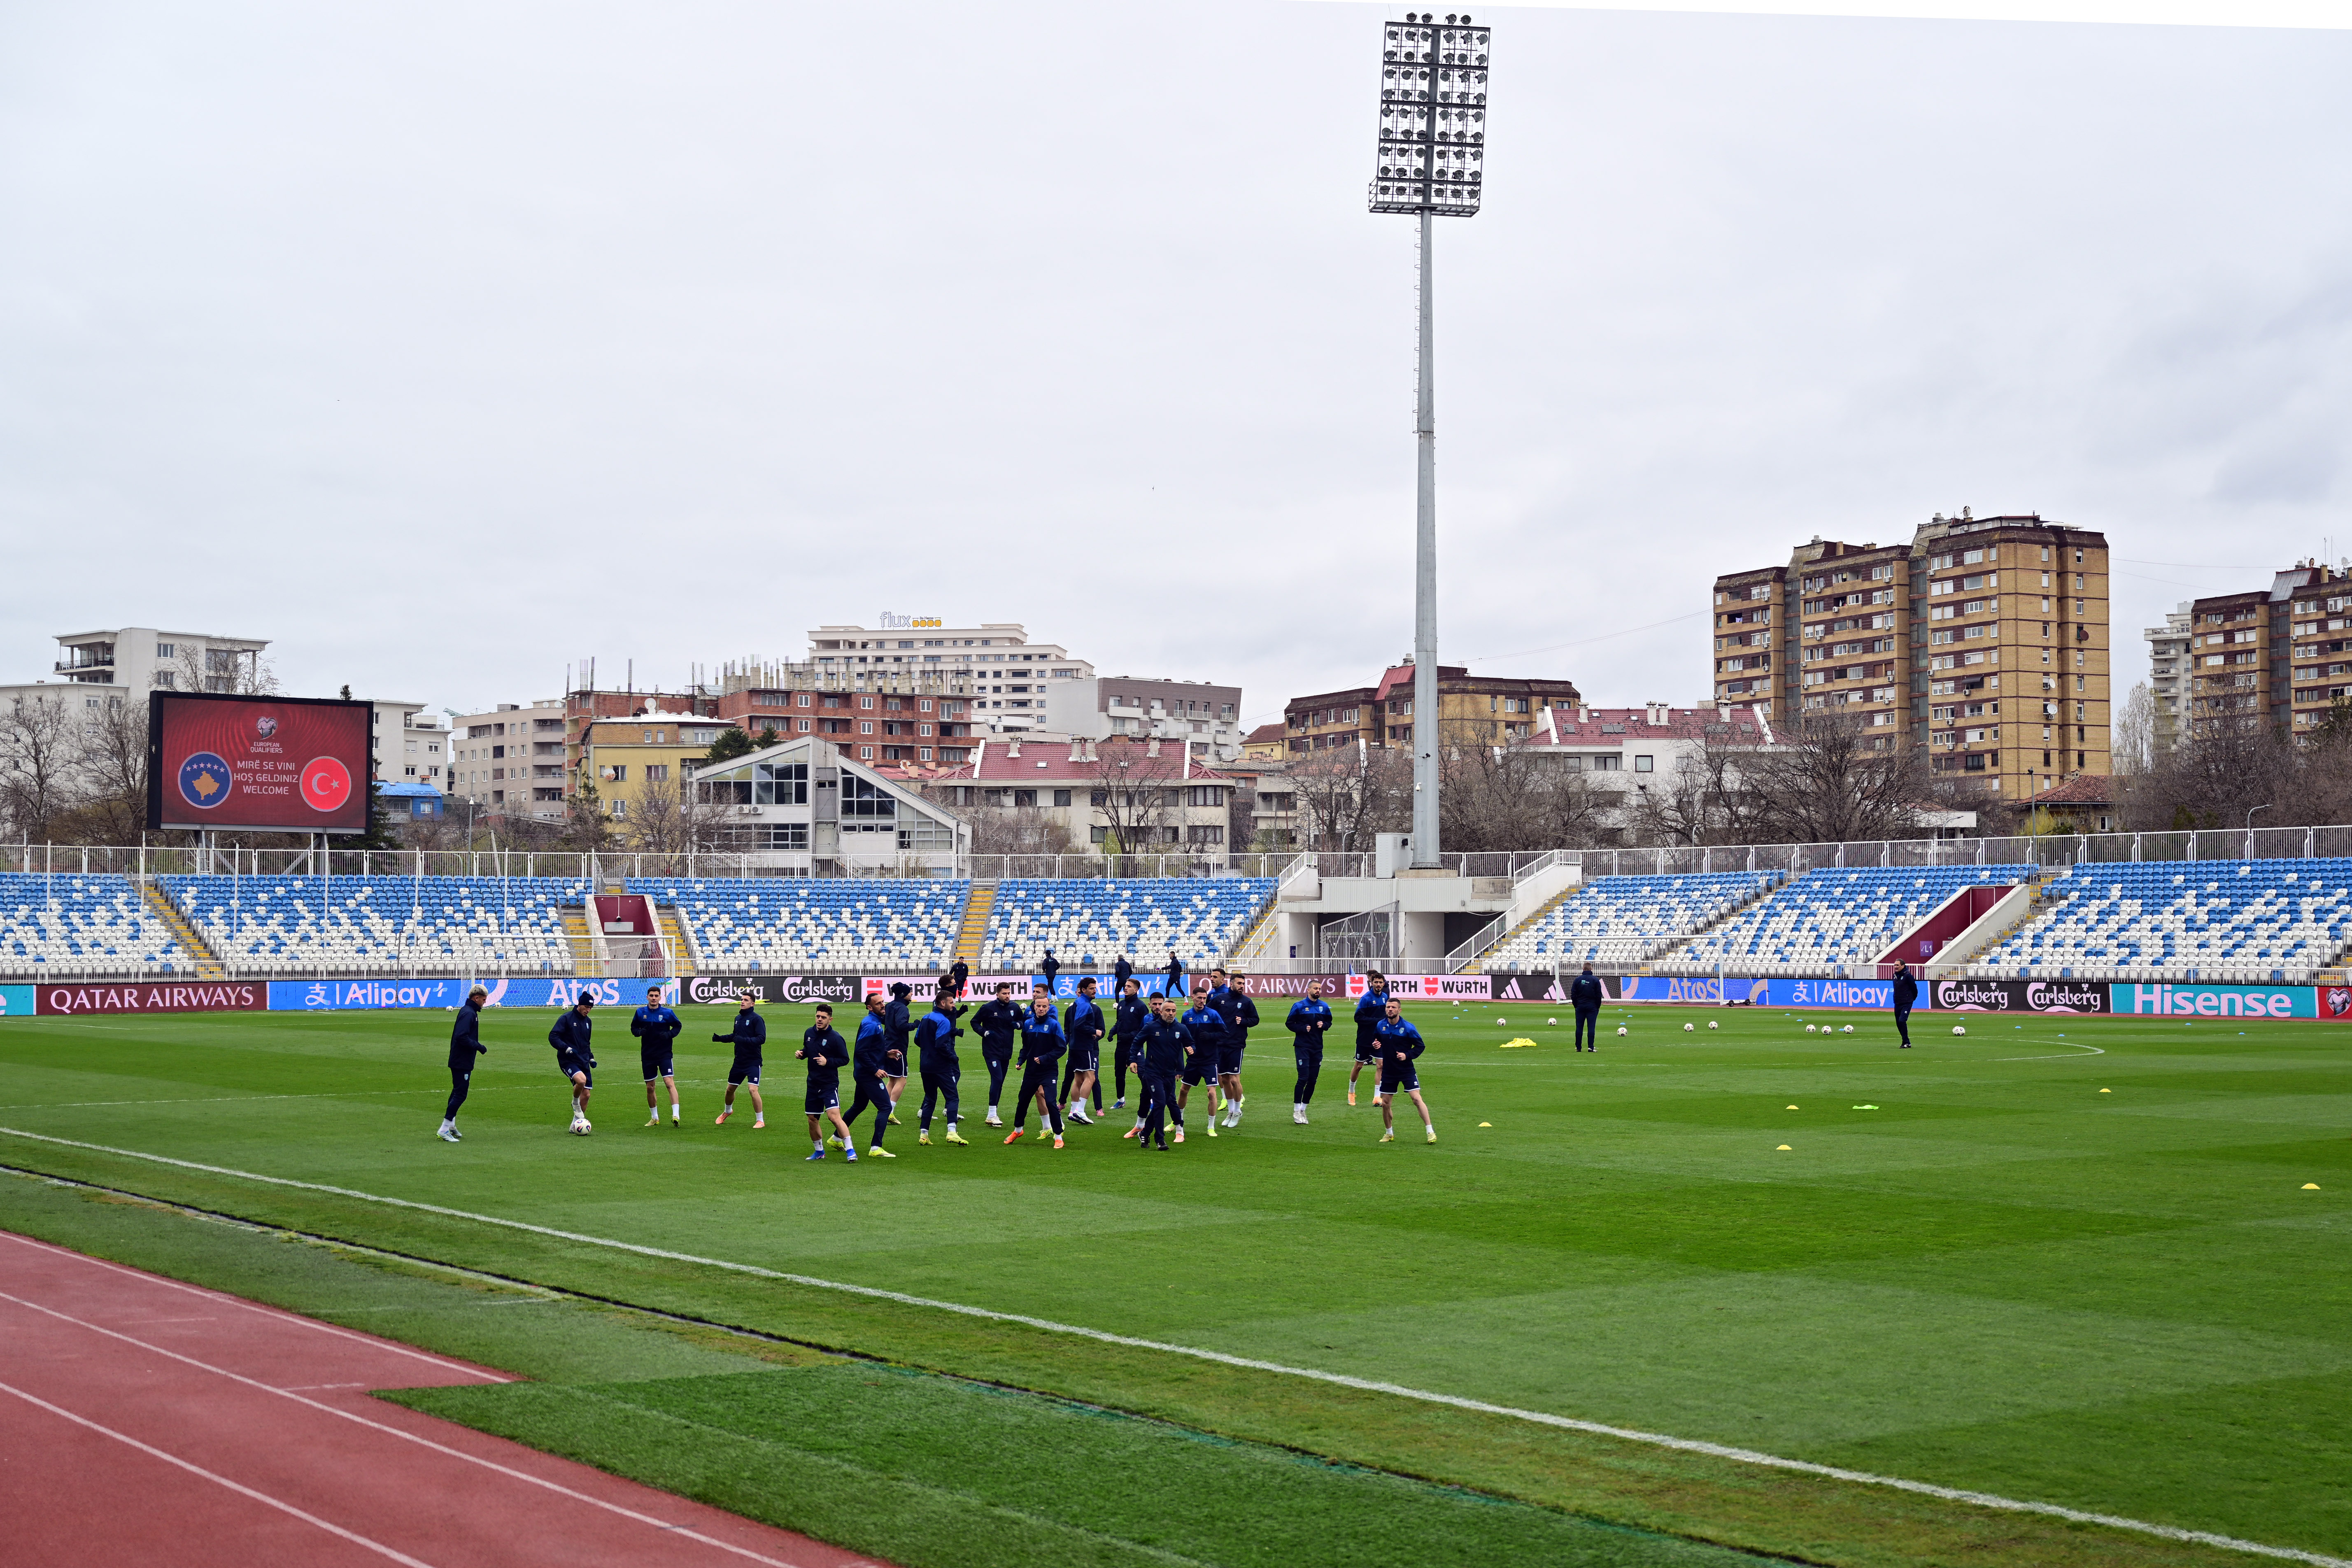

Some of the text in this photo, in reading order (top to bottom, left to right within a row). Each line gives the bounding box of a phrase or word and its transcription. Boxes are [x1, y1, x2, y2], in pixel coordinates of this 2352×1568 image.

[880, 611, 911, 628] flux
[237, 760, 295, 770] MIRË SE VINI
[234, 773, 298, 783] HOŞ GELDINIZ
[243, 785, 289, 794] WELCOME
[50, 986, 254, 1014] QATAR AIRWAYS
[689, 977, 764, 1003] Carlsberg
[782, 977, 853, 1002] Carlsberg
[971, 982, 1027, 995] WÜTH
[1937, 981, 2008, 1011] Carlsberg
[2027, 982, 2101, 1013] Carlsberg
[2134, 984, 2292, 1017] Hisense
